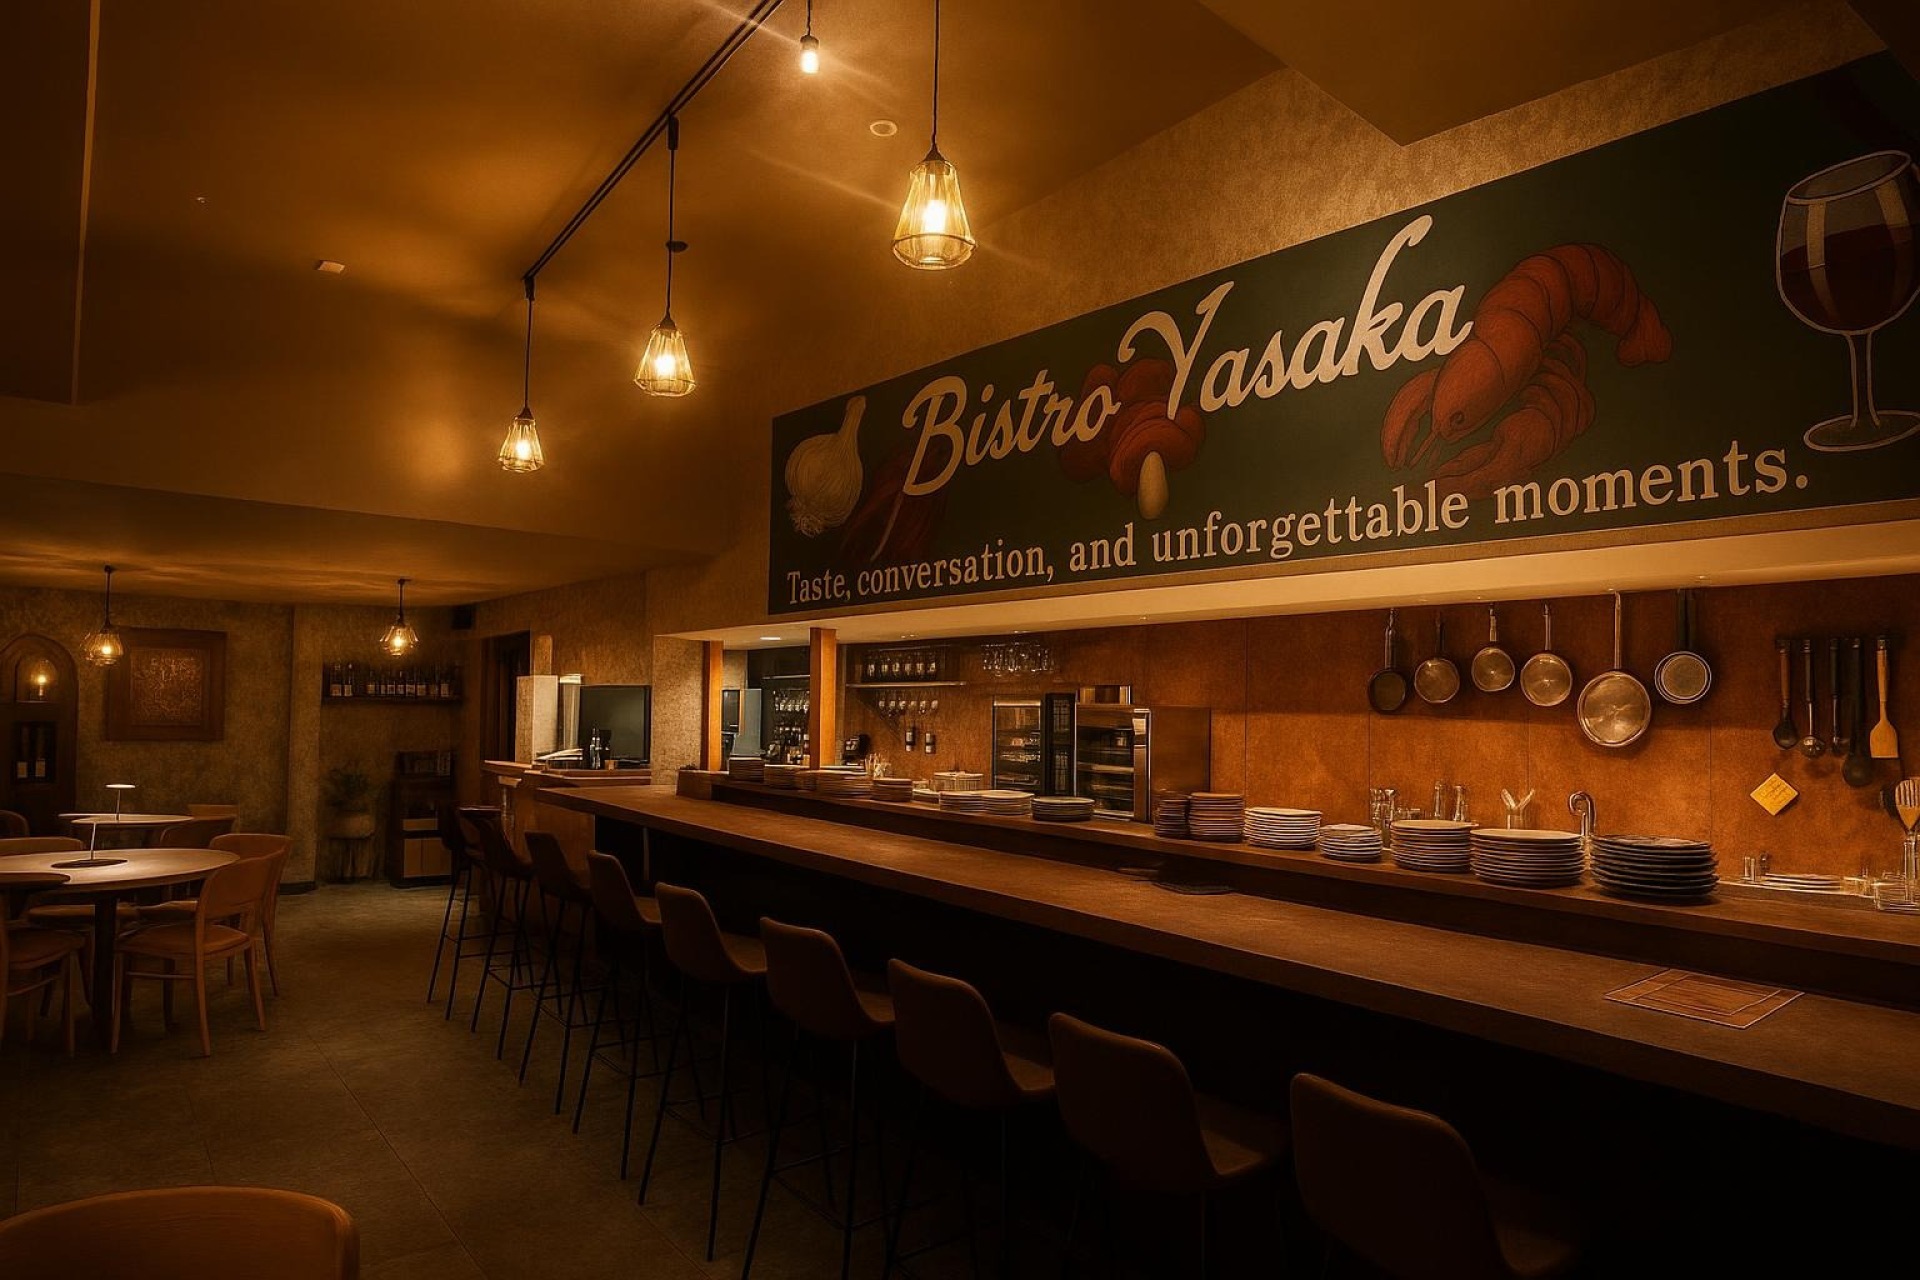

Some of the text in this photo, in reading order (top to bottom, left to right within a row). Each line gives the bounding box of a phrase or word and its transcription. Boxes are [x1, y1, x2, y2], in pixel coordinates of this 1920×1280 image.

[902, 214, 1474, 496] Bistro Yasaka
[787, 440, 1809, 605] Taste, conversation, and unforgettable moments.
